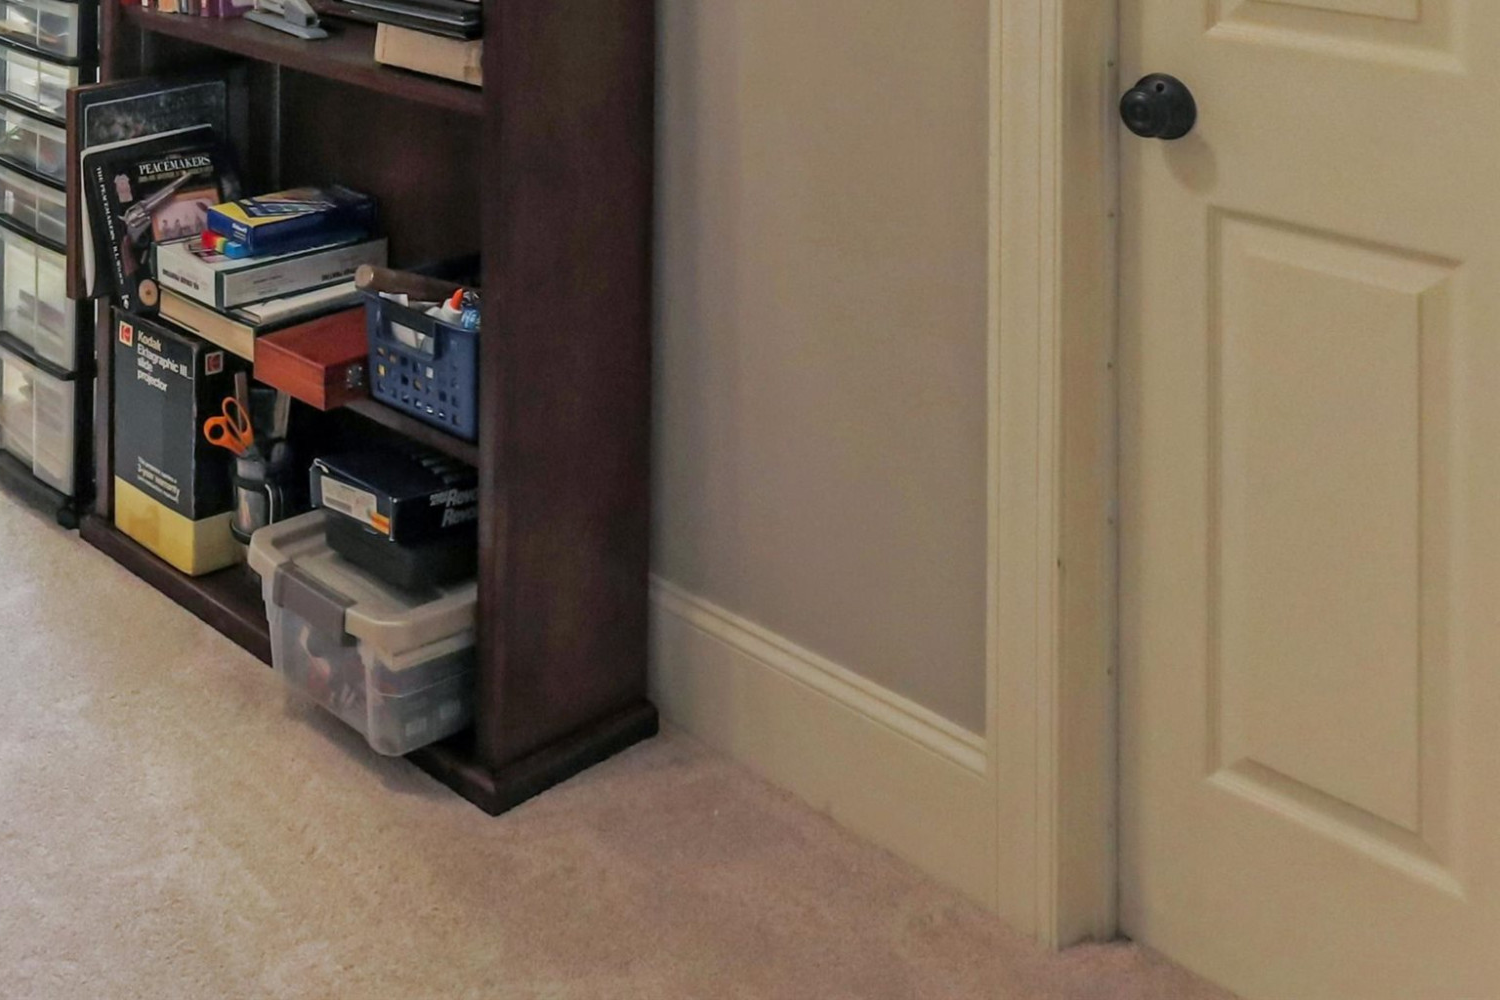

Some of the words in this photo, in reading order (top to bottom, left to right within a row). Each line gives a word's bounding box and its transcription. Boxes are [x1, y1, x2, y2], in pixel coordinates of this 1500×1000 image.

[138, 156, 211, 175] PEACEMAKERS
[137, 330, 162, 352] Kodak
[137, 342, 180, 373] Ektagraphic
[137, 356, 153, 373] slide
[137, 369, 168, 392] projector
